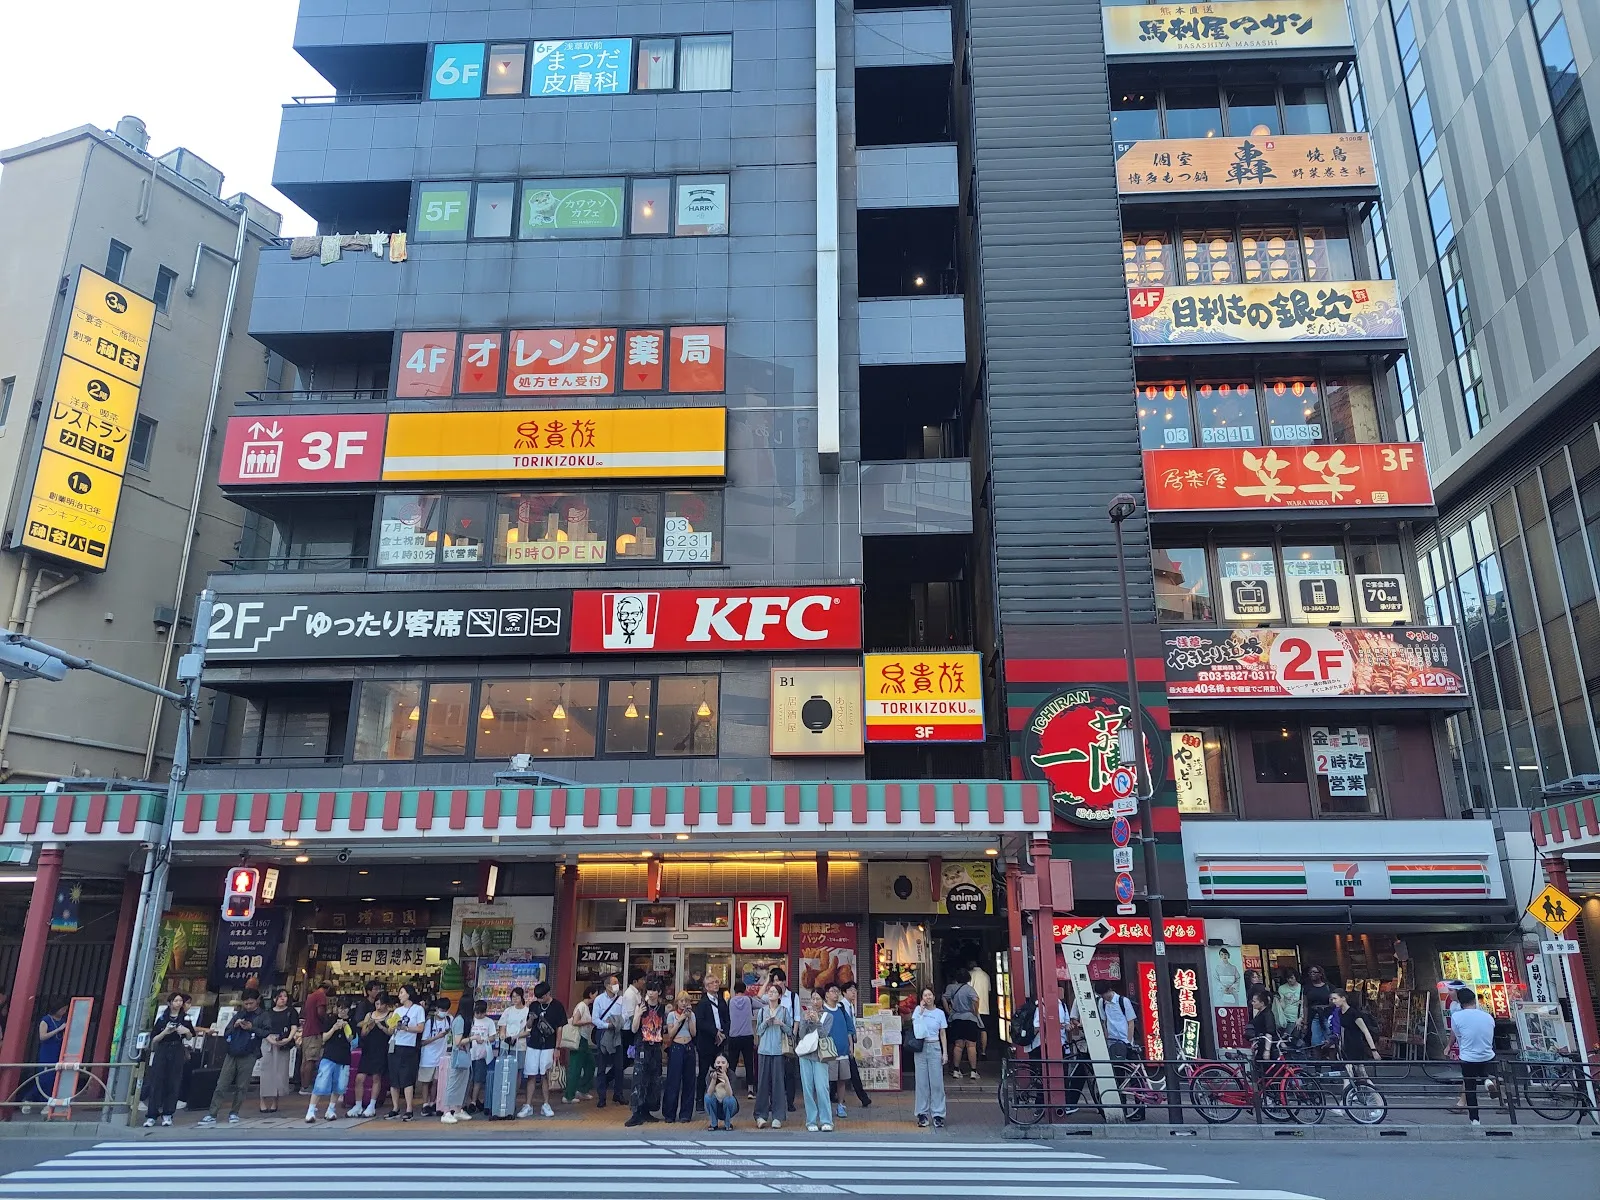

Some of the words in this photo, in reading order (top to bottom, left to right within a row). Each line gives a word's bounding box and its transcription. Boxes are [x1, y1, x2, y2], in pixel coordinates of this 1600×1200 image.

[1160, 5, 1214, 16] 熊本直送
[536, 42, 553, 54] 6F
[563, 41, 604, 51] 浅草駅前
[1177, 41, 1231, 50] BASASHIYA
[1235, 39, 1278, 48] MASASHI
[547, 50, 620, 71] まつだ
[435, 57, 479, 86] 6F
[541, 70, 619, 94] 皮膚科
[1117, 144, 1130, 152] 5F
[1306, 146, 1348, 163] 焼鳥
[1153, 151, 1193, 168] 個室
[1225, 140, 1278, 185] 轟
[1128, 170, 1209, 185] 博多もつ鍋
[1291, 166, 1366, 180] 野菜巻き串
[425, 201, 462, 222] 5F
[564, 198, 608, 210] カワウソ
[571, 207, 600, 219] カフェ
[1131, 291, 1161, 308] 4F
[1171, 288, 1353, 331] 目利きの銀次
[1306, 322, 1339, 336] ぎんじ
[72, 329, 93, 347] 割烹
[95, 336, 141, 372] 神谷
[467, 334, 712, 368] オレンジ薬局
[405, 347, 447, 375] 4F
[517, 375, 603, 389] 処方せん受付
[53, 402, 128, 444] レストラン
[513, 418, 596, 450] 鳥貴族
[1166, 428, 1188, 443] 03
[1204, 425, 1255, 443] 3841
[1273, 423, 1323, 441] 0388
[59, 429, 115, 462] カミヤ
[296, 431, 369, 469] 3F
[512, 455, 596, 467] TORIKIZOKU
[1381, 447, 1415, 472] 3F
[1160, 467, 1227, 491] 居楽屋
[1233, 448, 1360, 503] 笑笑
[48, 491, 101, 516] 創業明治13年
[36, 503, 107, 535] デンキブランの
[665, 517, 687, 532] 03
[29, 520, 106, 558] 神谷バー
[381, 536, 425, 546] 金土祝前
[664, 533, 712, 548] 6231
[380, 549, 435, 561] 朝4時30分
[444, 548, 478, 560] まで営業
[507, 544, 606, 563] 15時OPEN
[663, 547, 711, 562] 7794
[207, 602, 264, 640] 2F
[305, 608, 464, 639] ゆったり客席
[686, 594, 833, 642] KFC
[1167, 637, 1264, 671] やきとり道場
[1279, 637, 1345, 681] 2F
[780, 676, 795, 687] B1
[880, 661, 966, 695] 鳥貴族
[1208, 671, 1276, 681] 03-5827-0317
[1410, 672, 1456, 687] 各120円
[787, 696, 797, 733] 居酒屋
[835, 696, 845, 736] あさくさ
[880, 701, 968, 715] TORIKIZOKU
[1031, 690, 1091, 735] ICHIRAN
[915, 725, 934, 738] 3F
[1317, 752, 1366, 772] 2時迄
[1329, 774, 1365, 792] 営業
[1196, 797, 1207, 806] 2F
[950, 893, 982, 902] animal
[955, 901, 977, 911] cafe
[255, 919, 271, 927] 1867
[801, 922, 840, 934] 創業記念
[801, 933, 826, 944] パック
[580, 950, 619, 961] 2階77席
[1545, 943, 1575, 952] 通学路
[225, 954, 263, 969] 増田園
[1245, 959, 1261, 968] SIM
[1079, 973, 1101, 1038] 馬道通り
[1228, 1008, 1238, 1047] VASARA
